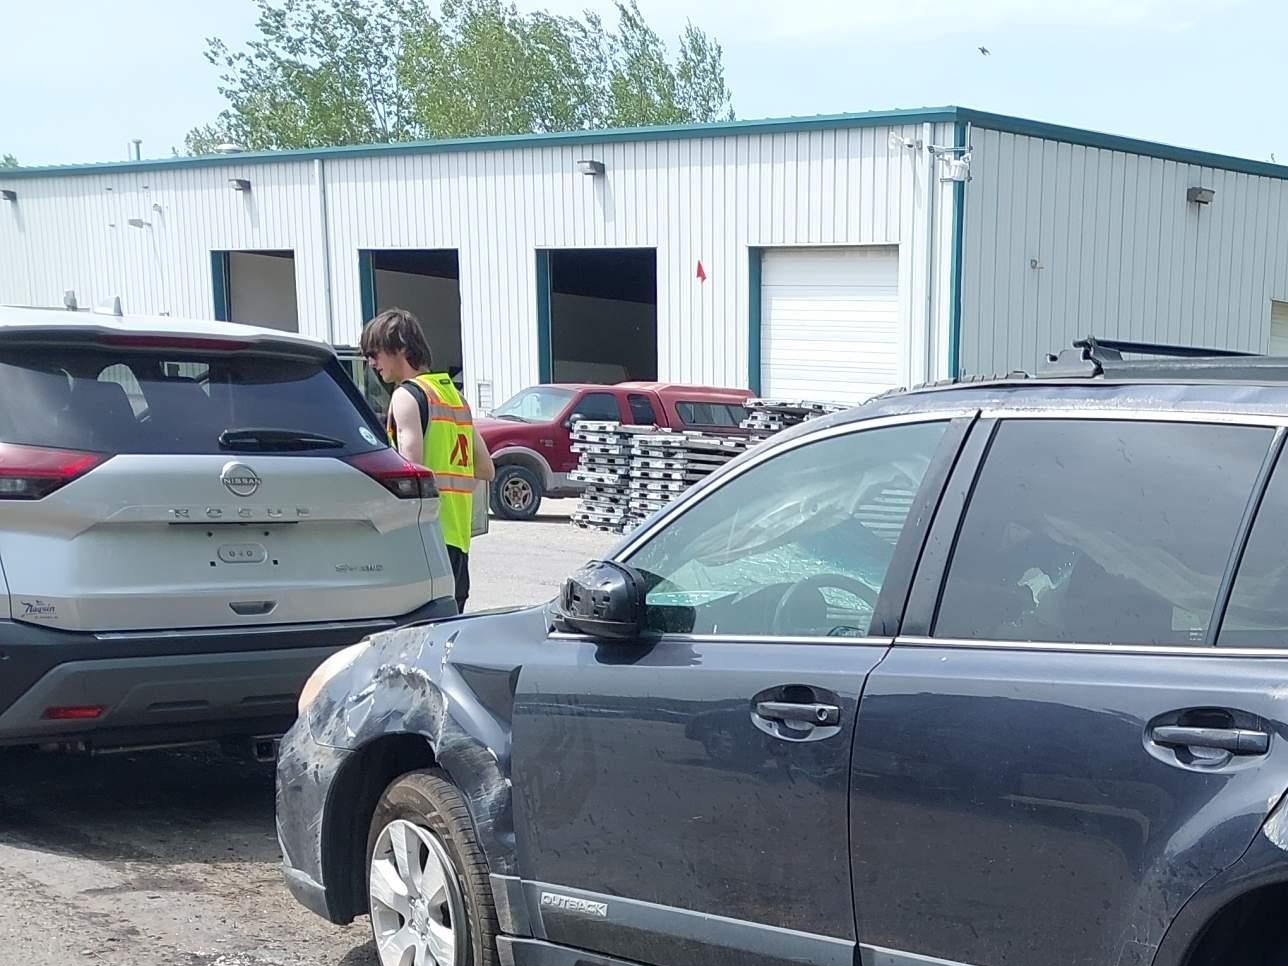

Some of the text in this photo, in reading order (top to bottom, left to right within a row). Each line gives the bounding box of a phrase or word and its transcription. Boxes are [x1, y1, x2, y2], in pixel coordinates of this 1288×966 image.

[222, 476, 262, 486] NISSAN
[168, 506, 311, 519] ROGUE
[541, 892, 608, 917] OUTBACK
